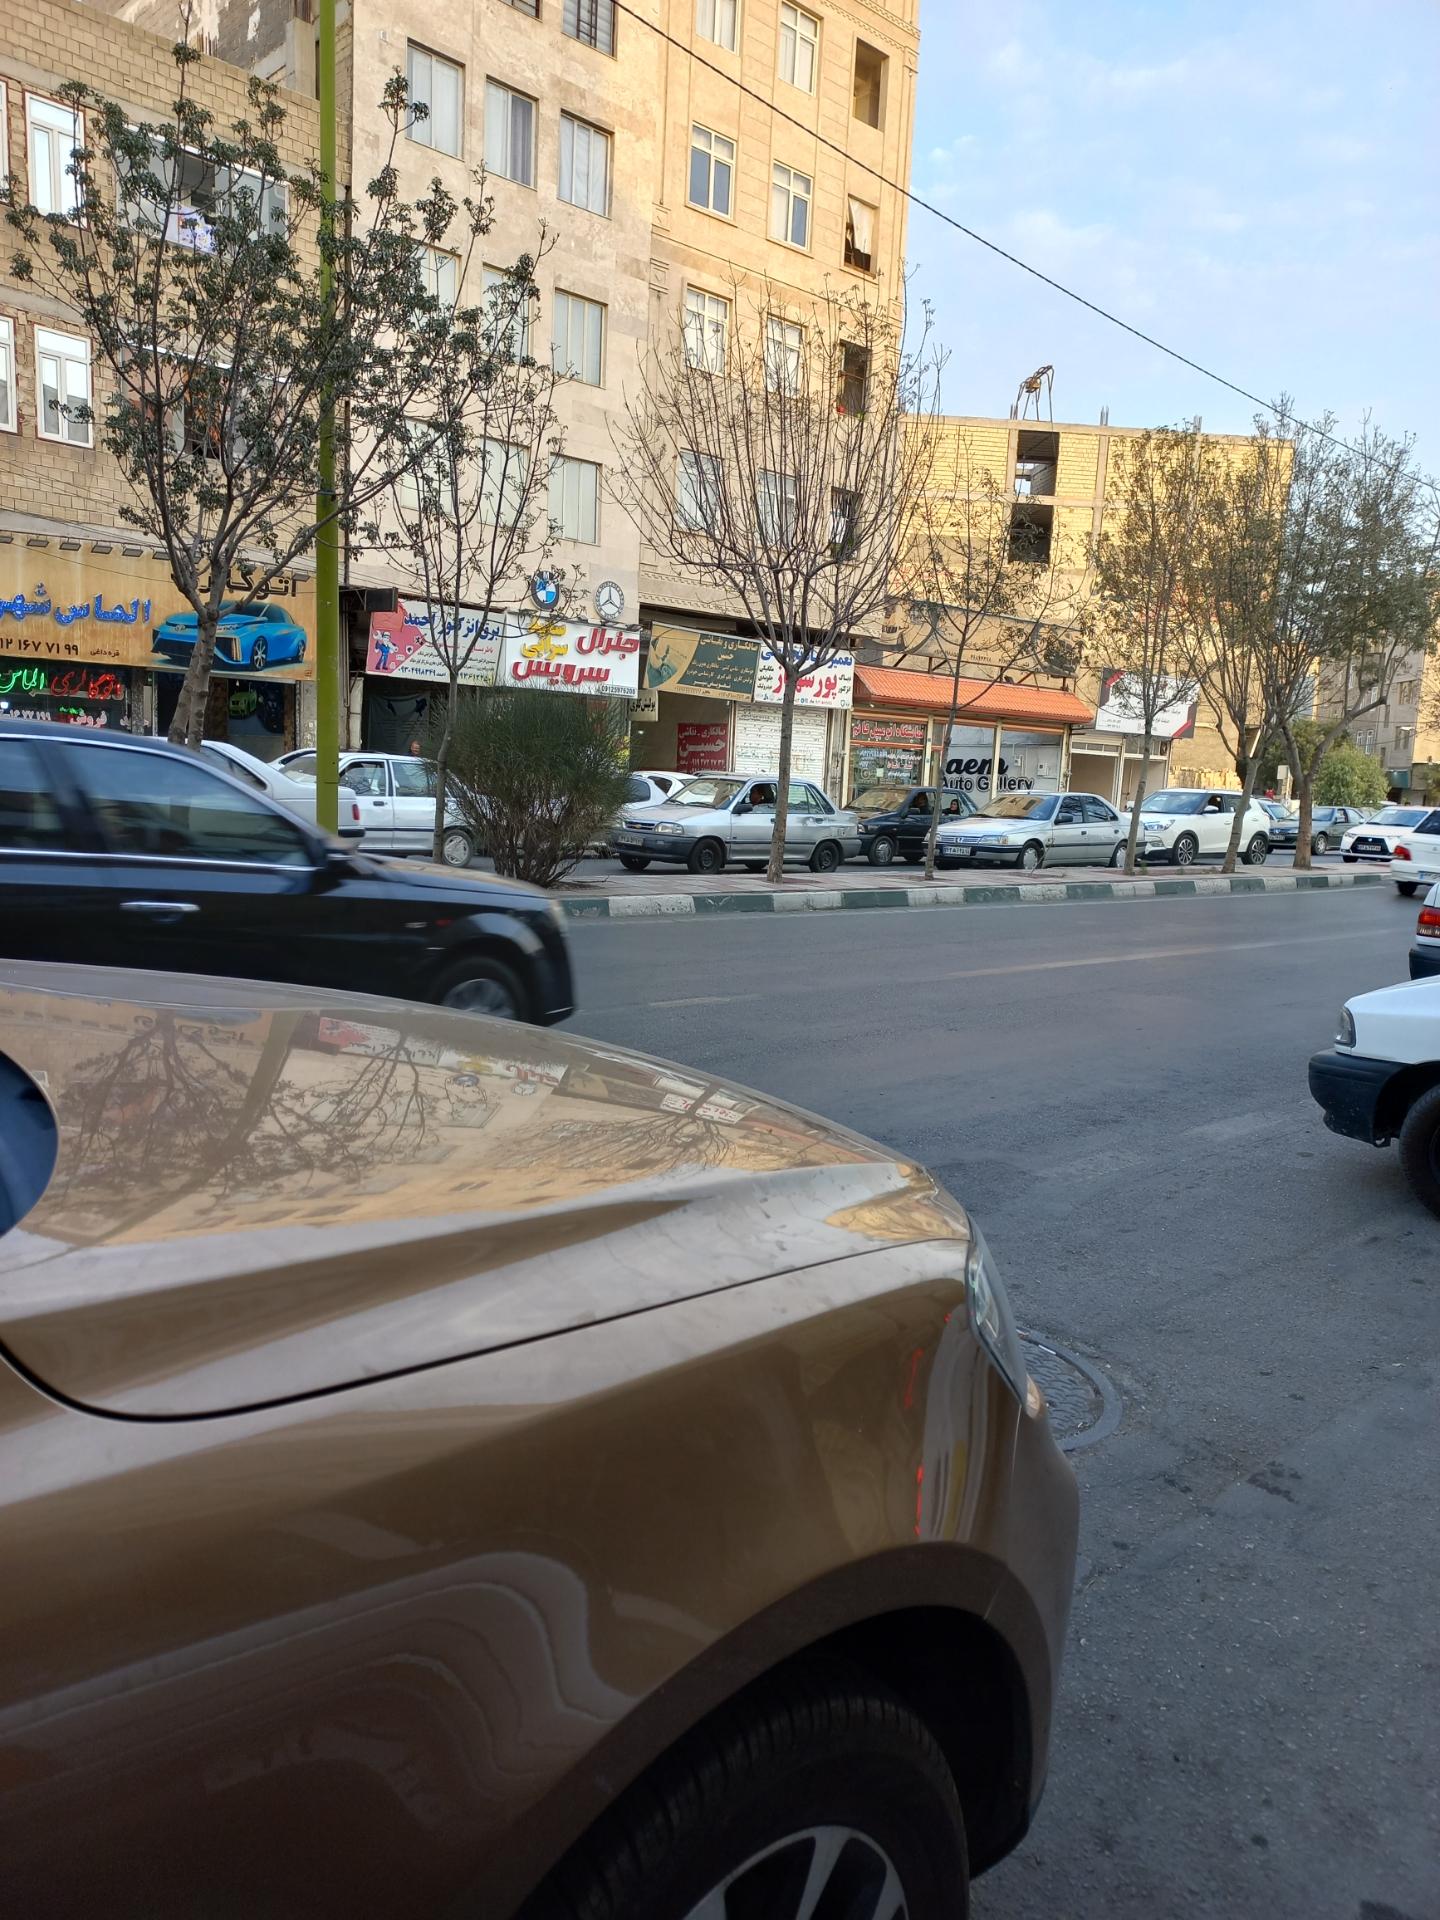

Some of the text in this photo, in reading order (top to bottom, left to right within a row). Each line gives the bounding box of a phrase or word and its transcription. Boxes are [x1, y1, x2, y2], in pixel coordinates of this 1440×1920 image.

[55, 592, 151, 625] الماس
[577, 628, 640, 659] جنرال
[512, 660, 610, 685] سرویس
[679, 739, 726, 757] حسین
[977, 775, 1034, 792] Gllery
